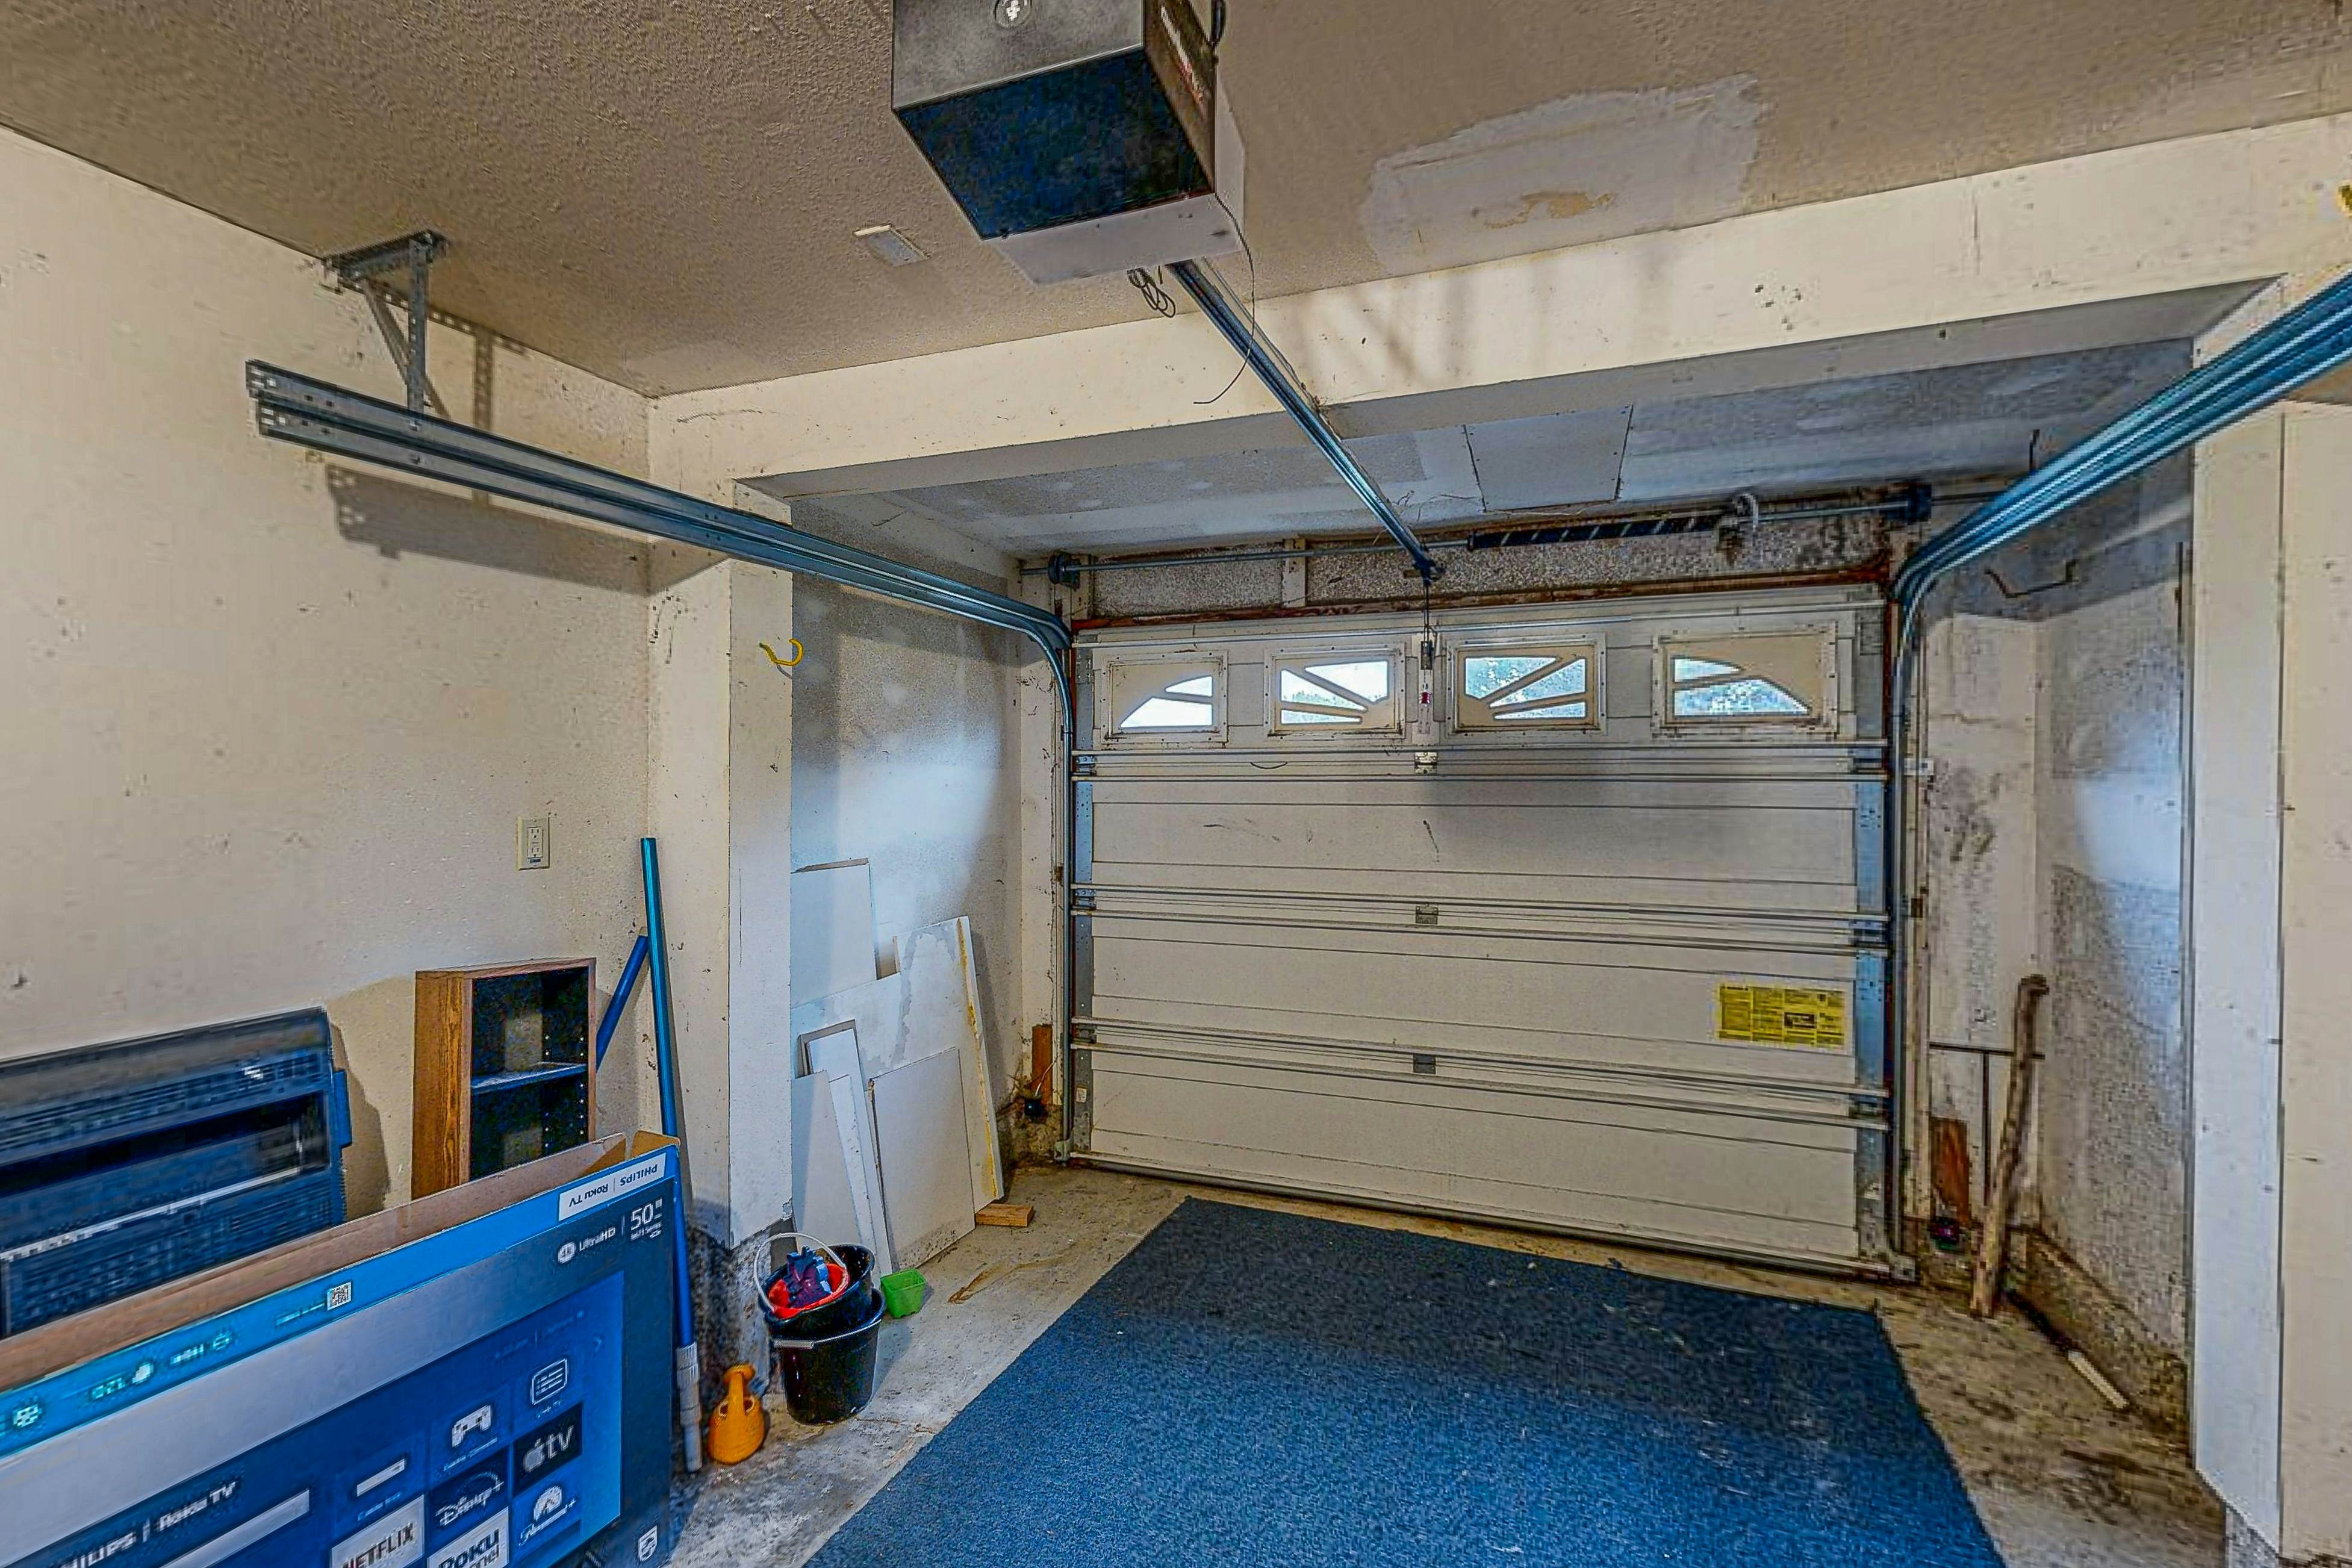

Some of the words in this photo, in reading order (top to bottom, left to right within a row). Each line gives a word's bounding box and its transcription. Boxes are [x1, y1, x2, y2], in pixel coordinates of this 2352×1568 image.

[620, 1164, 658, 1186] PHILIPS
[569, 1193, 583, 1207] TV
[546, 1425, 573, 1460] tv
[209, 1481, 237, 1504] TV
